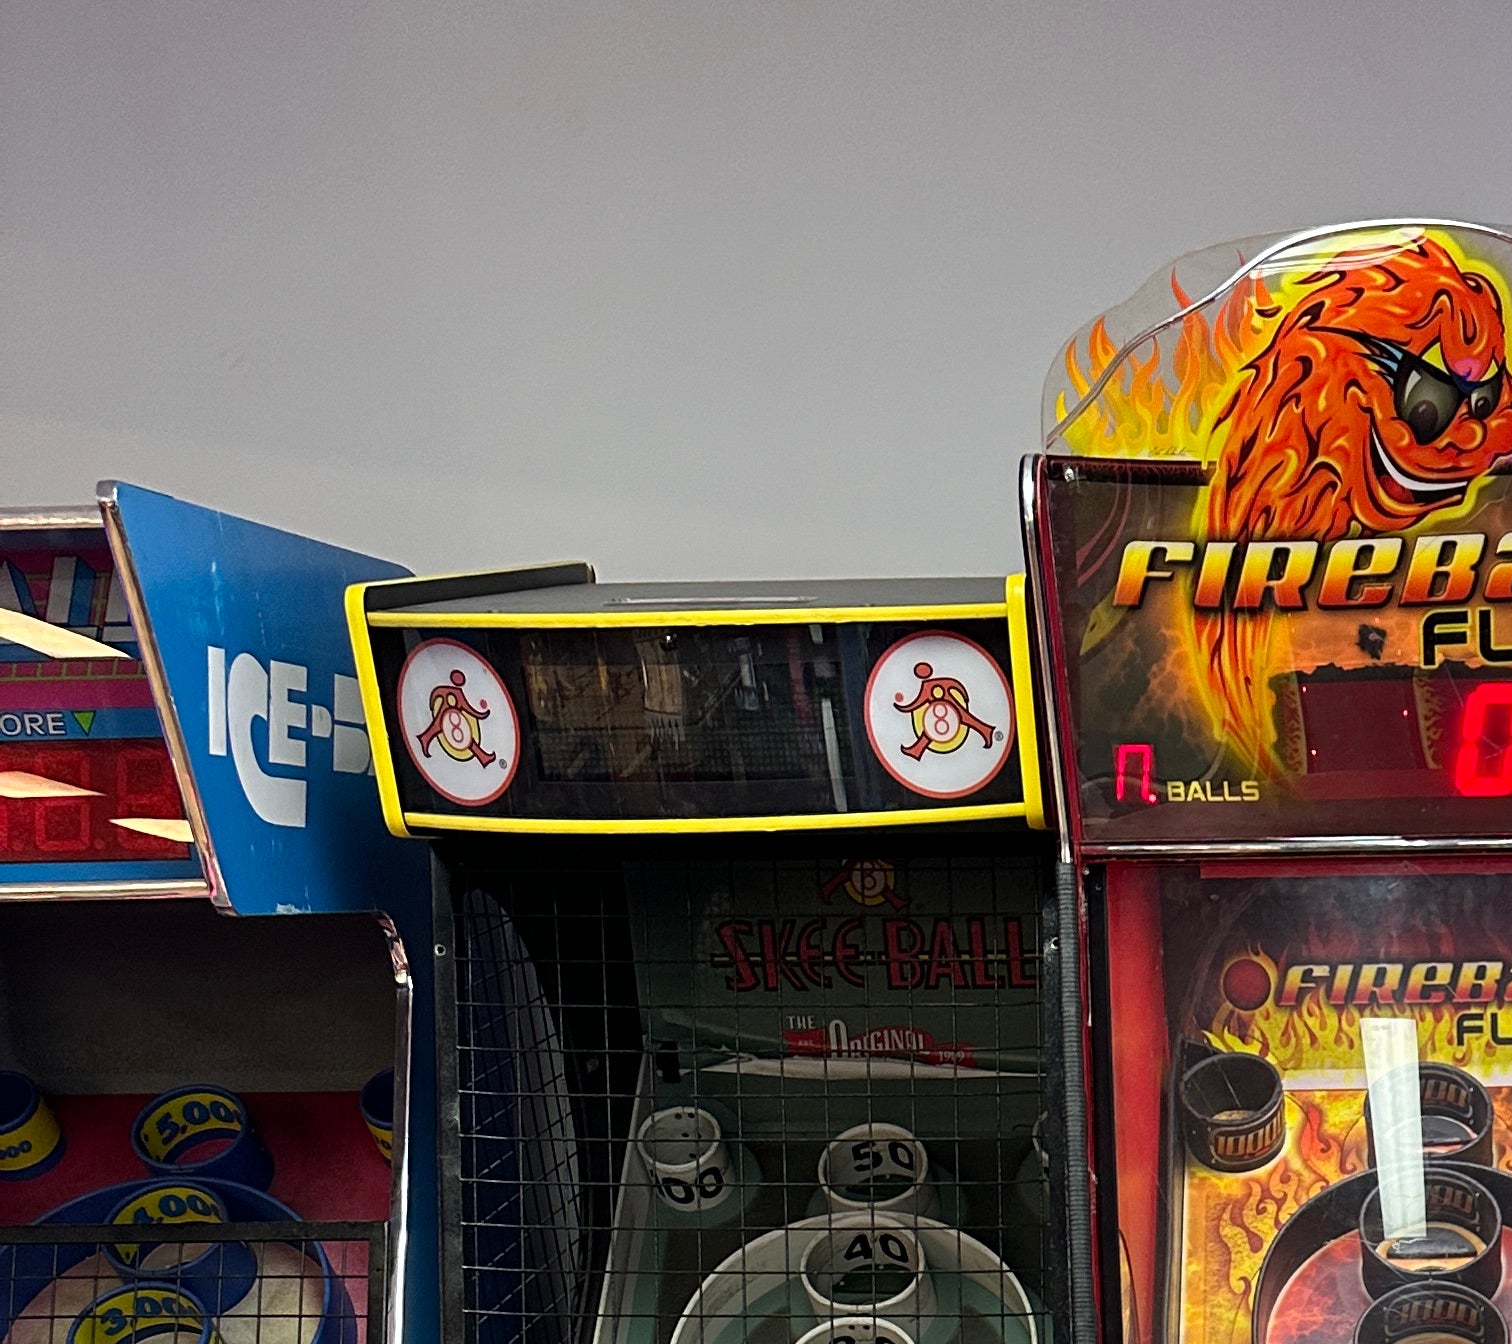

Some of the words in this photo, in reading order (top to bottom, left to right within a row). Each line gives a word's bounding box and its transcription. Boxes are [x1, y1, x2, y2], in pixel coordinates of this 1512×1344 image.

[207, 645, 375, 828] ICE-B
[1167, 780, 1260, 802] BALLS
[852, 1140, 916, 1172] 50
[843, 1232, 909, 1264] 40
